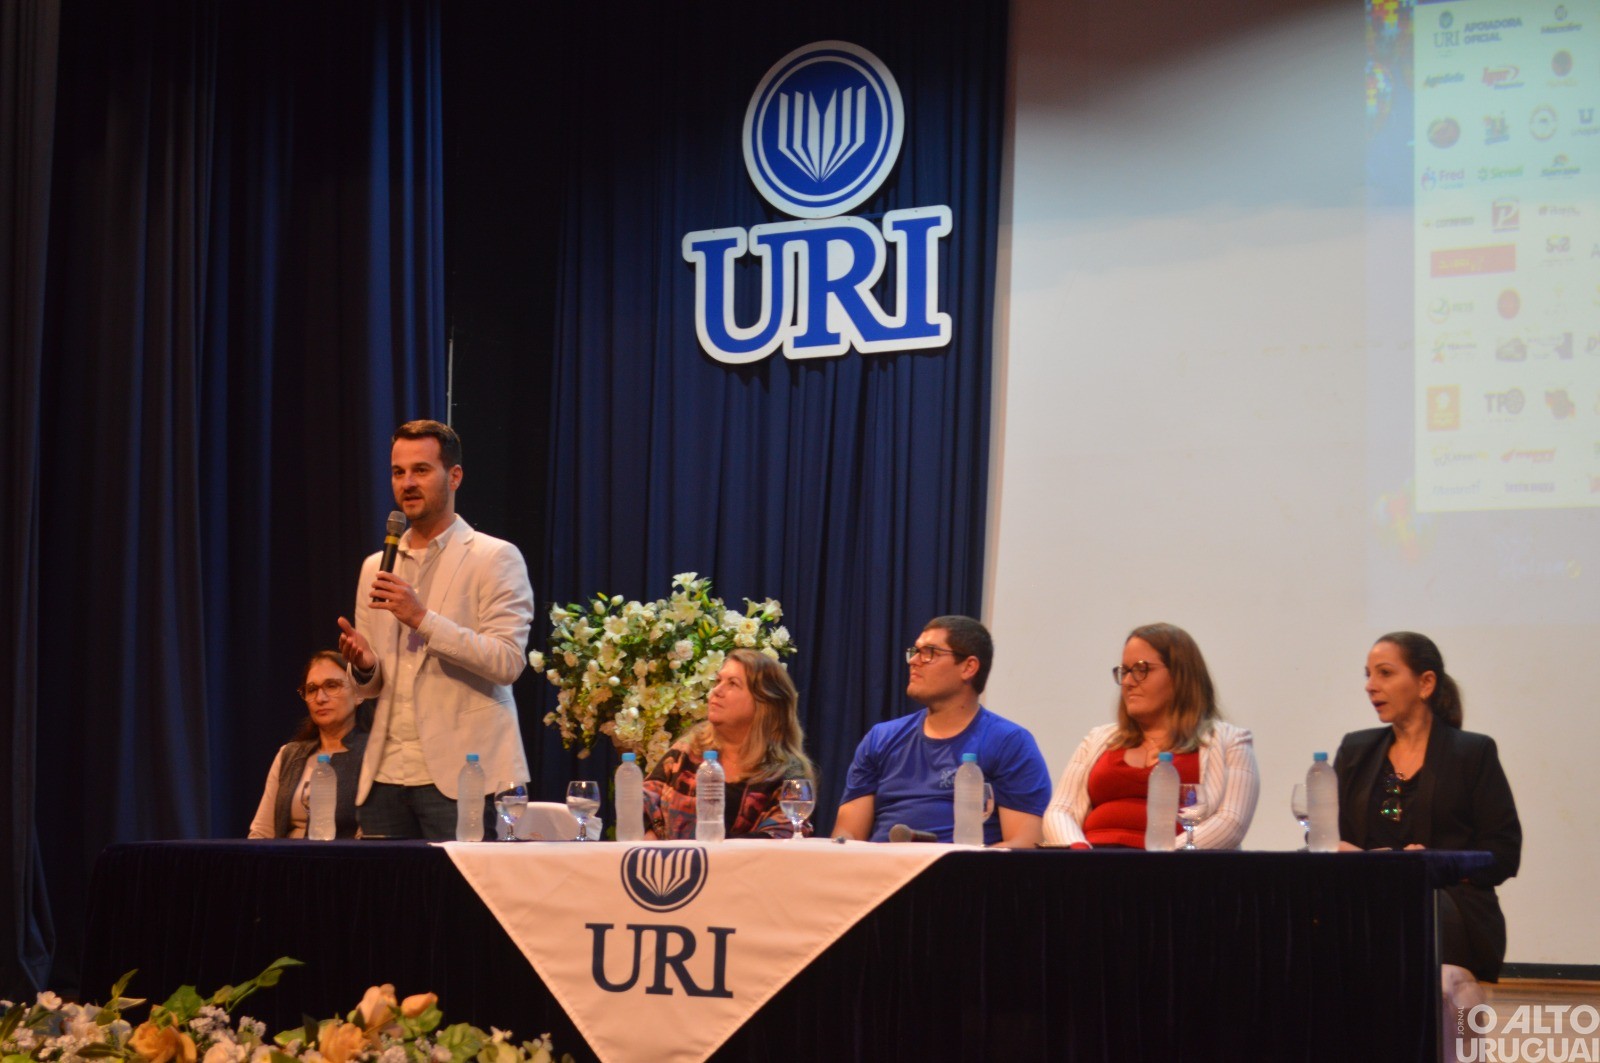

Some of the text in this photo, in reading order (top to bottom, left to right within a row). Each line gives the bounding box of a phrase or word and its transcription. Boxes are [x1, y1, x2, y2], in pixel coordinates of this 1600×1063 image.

[1464, 17, 1523, 33] APOIADORA
[1434, 30, 1460, 48] URI
[1464, 33, 1502, 45] OFICIAL
[688, 212, 945, 356] URI
[585, 923, 736, 999] URI
